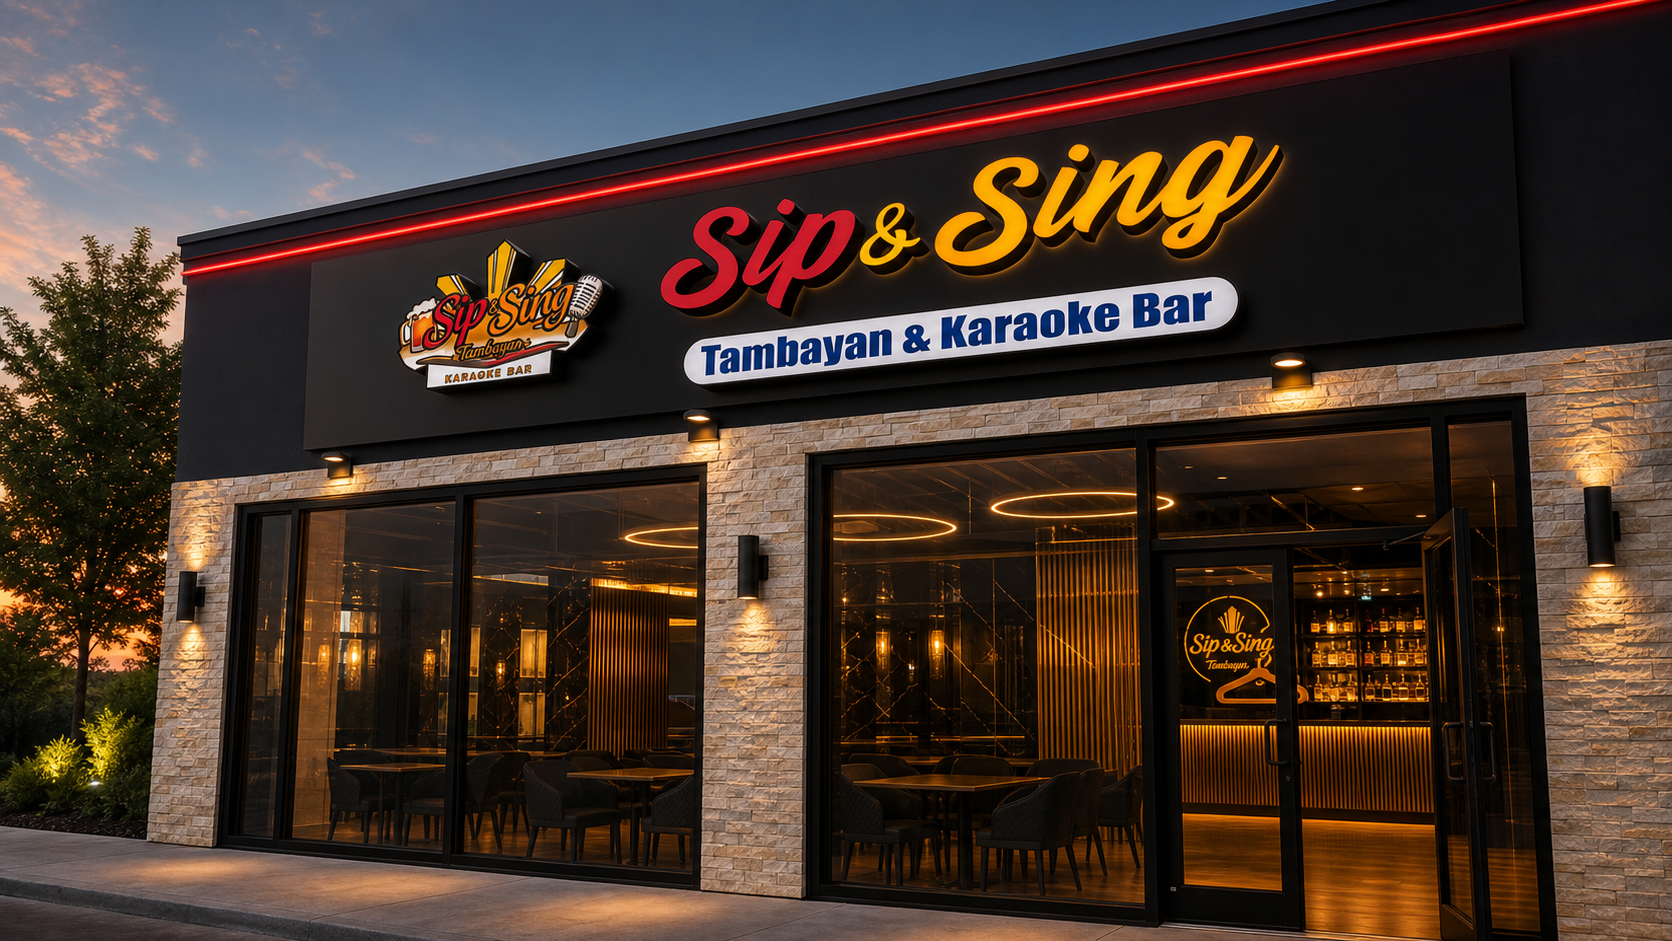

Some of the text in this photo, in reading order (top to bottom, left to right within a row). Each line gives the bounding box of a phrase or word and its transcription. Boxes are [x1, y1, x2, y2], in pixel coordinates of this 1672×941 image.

[660, 136, 1281, 309] Sip & Sing
[423, 295, 488, 346] Sip
[488, 284, 574, 335] Sing
[700, 288, 1213, 376] Tambayan & Karaoke Bar
[445, 364, 532, 384] KARAOKE BAR
